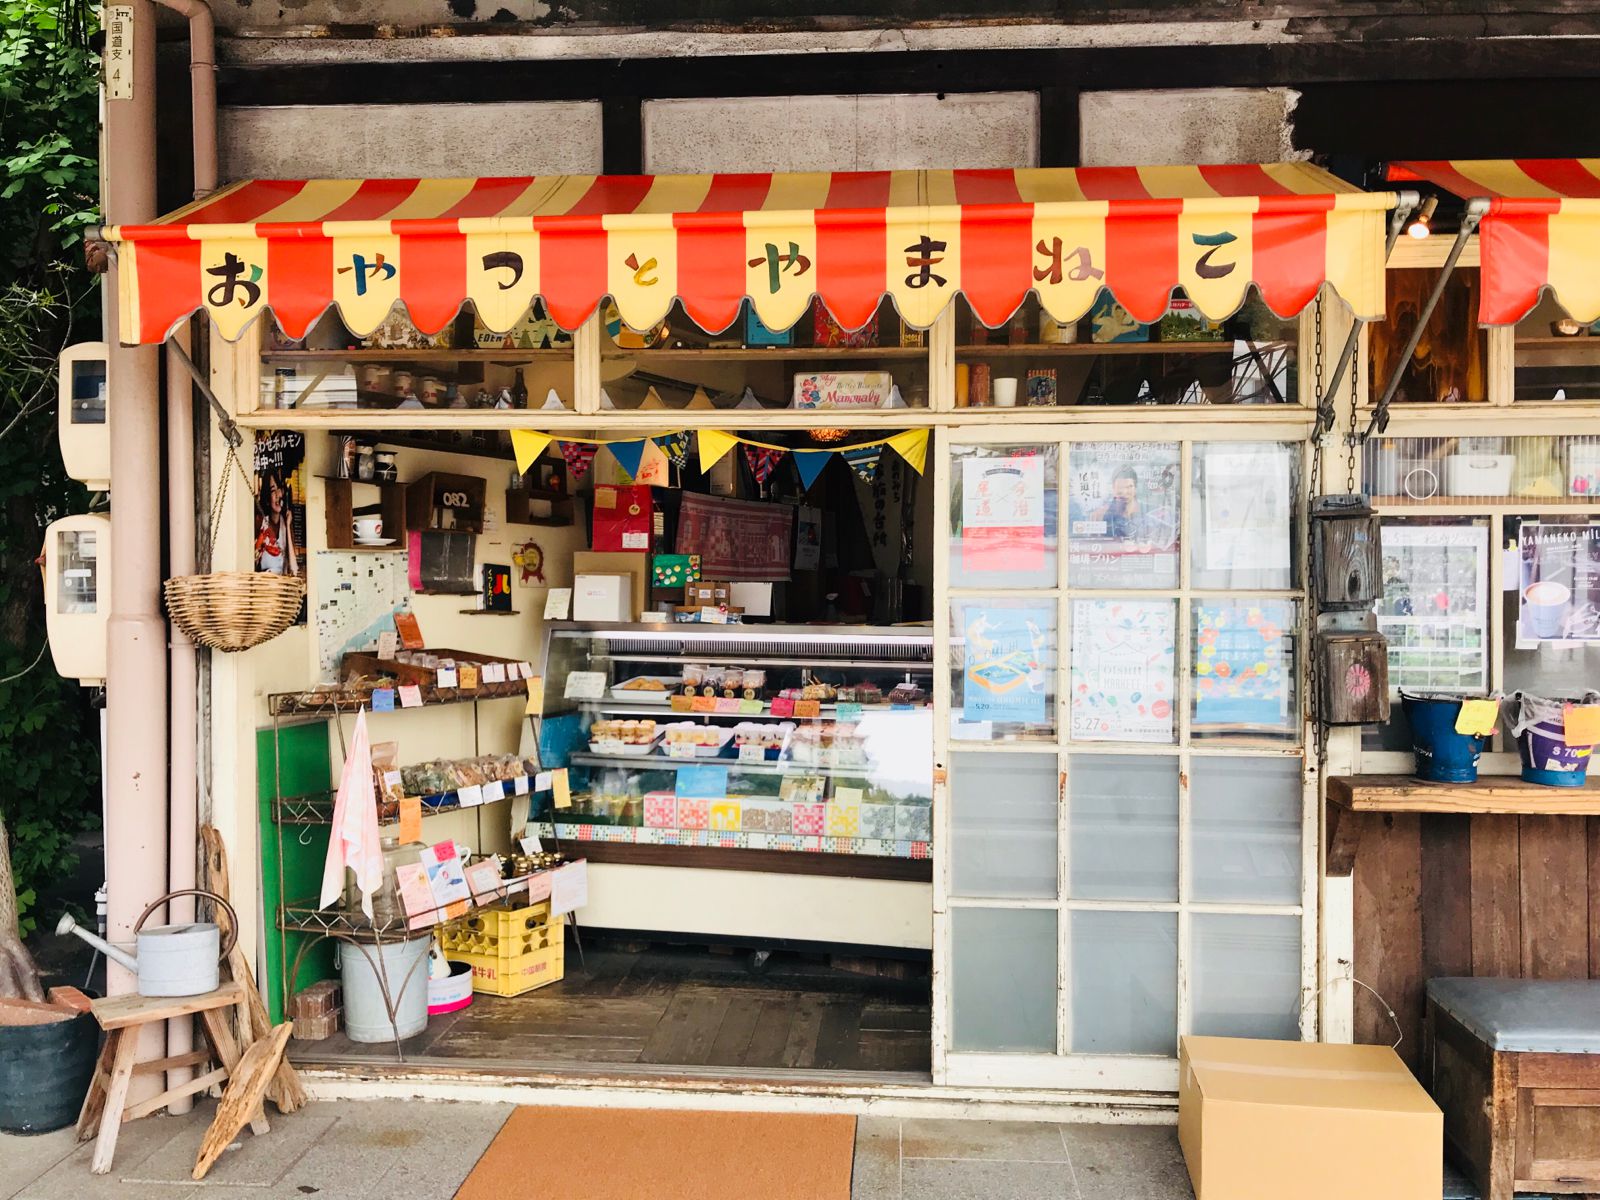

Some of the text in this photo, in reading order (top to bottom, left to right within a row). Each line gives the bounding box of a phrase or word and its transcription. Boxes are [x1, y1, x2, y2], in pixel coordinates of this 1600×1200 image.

[111, 21, 123, 82] 国道支 4
[206, 231, 1239, 310] おやつとやまねこ
[1522, 531, 1577, 546] YAMANEKO
[1073, 717, 1100, 731] 5.27
